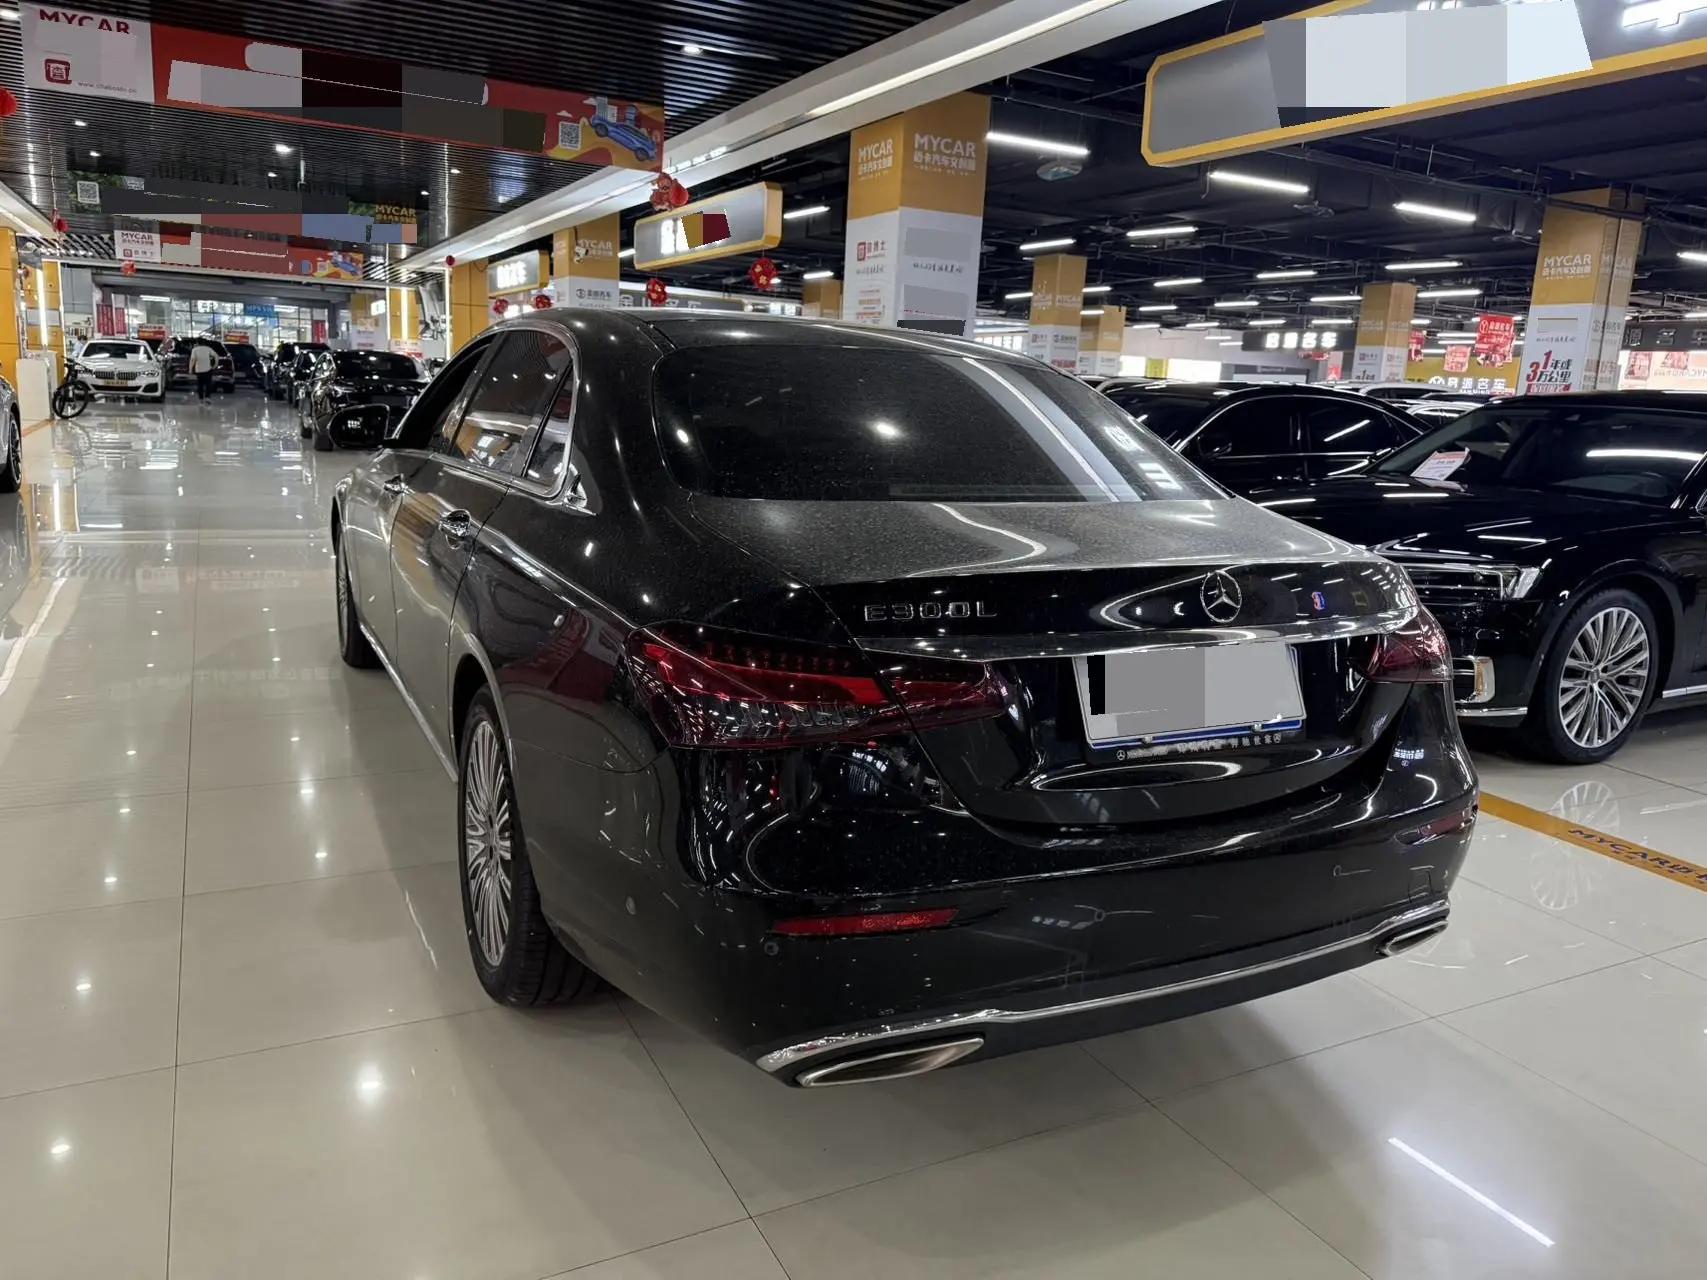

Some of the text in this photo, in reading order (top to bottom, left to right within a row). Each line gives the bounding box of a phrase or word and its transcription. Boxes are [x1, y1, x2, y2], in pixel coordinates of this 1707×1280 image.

[858, 139, 893, 162] MYCAR
[915, 133, 976, 157] MYCAR
[375, 204, 416, 217] MYCAR
[121, 232, 153, 241] MYCAR
[1544, 254, 1592, 267] MYCAR
[864, 601, 997, 621] E300L
